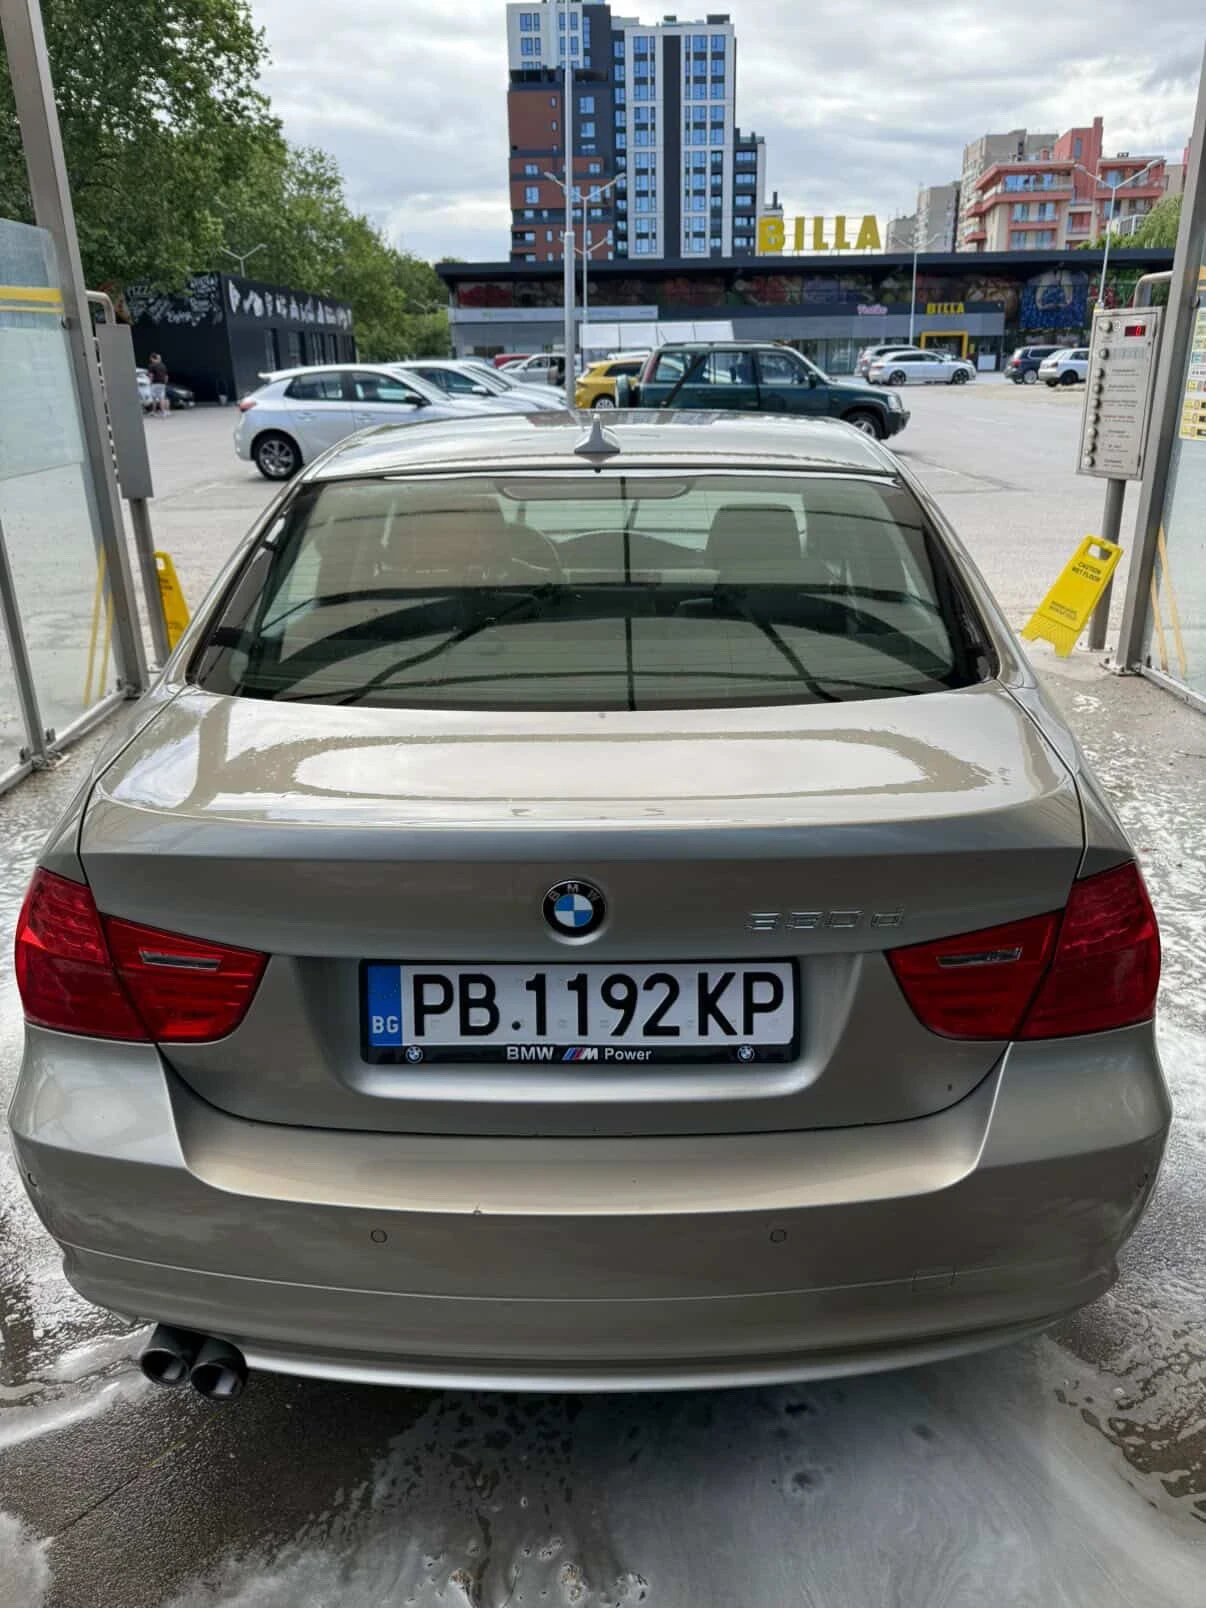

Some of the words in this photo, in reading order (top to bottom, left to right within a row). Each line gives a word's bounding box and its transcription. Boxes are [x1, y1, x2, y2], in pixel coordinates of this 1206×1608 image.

[758, 215, 881, 252] BILLA
[926, 302, 965, 315] BILLA
[548, 883, 601, 902] BMW
[372, 1016, 399, 1034] BG
[506, 1046, 555, 1061] BMW
[603, 1047, 653, 1061] Power
